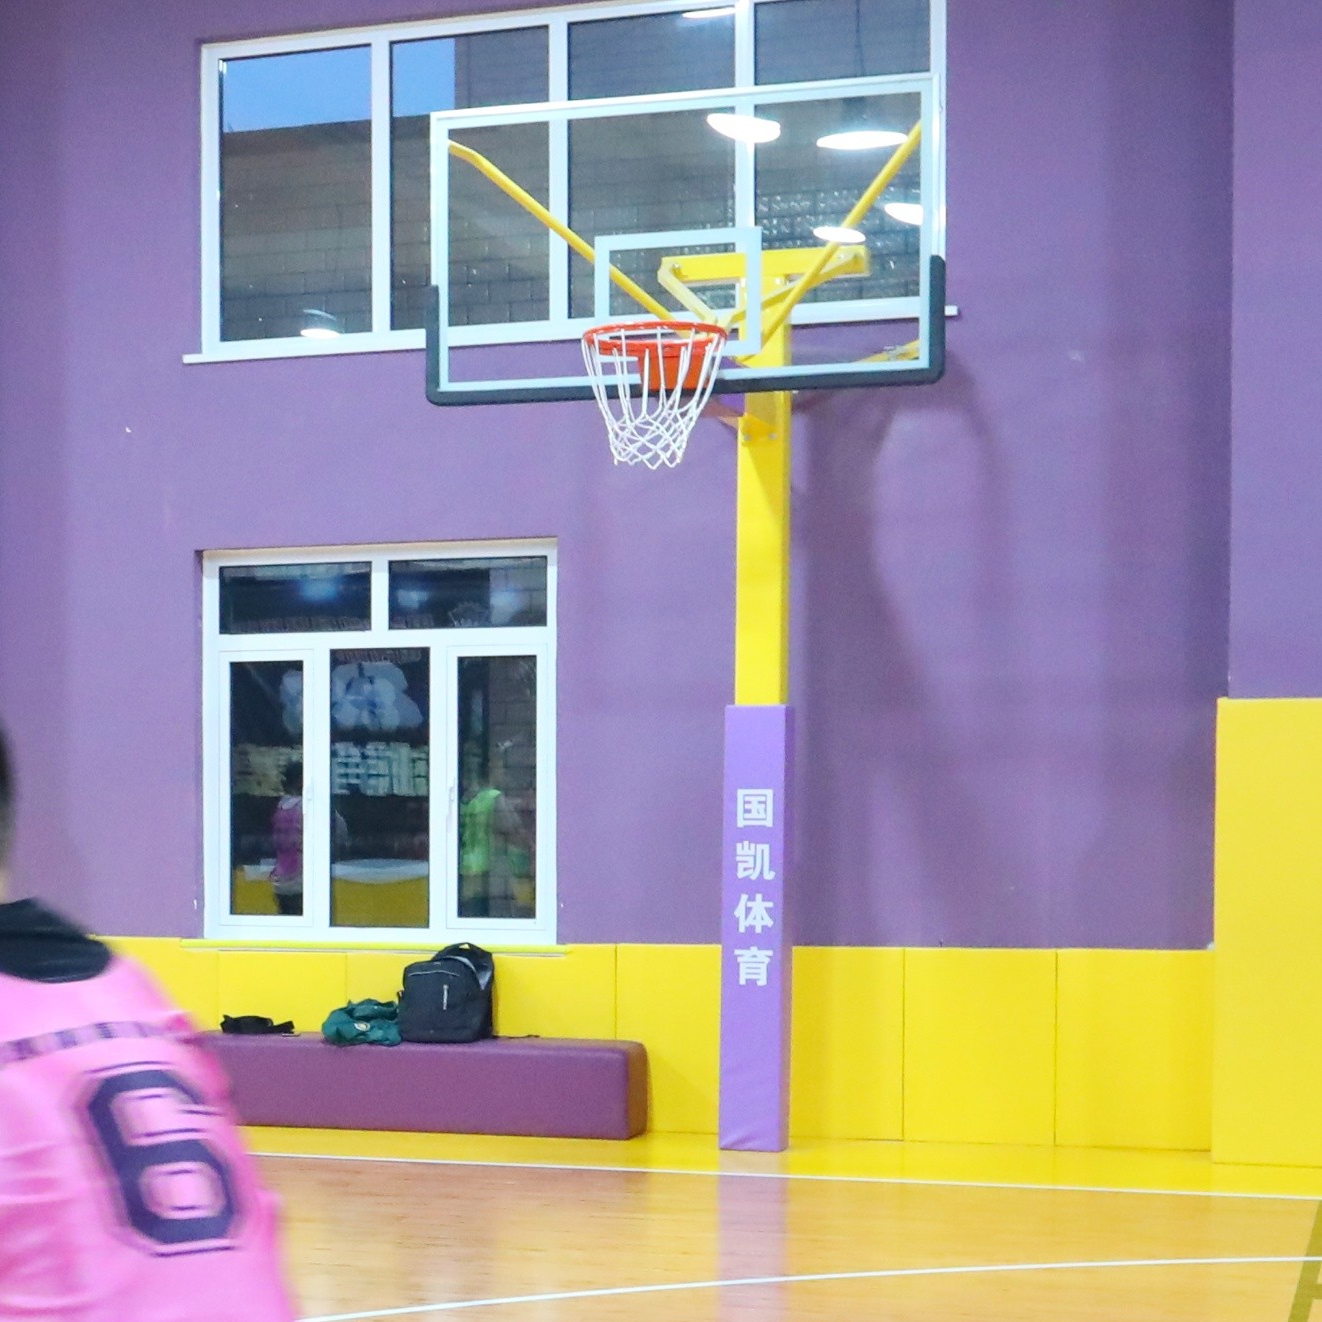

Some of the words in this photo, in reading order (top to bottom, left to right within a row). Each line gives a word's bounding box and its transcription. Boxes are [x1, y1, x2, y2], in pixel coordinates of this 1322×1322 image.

[733, 788, 776, 986] 国凯体育
[81, 1060, 237, 1258] 6
